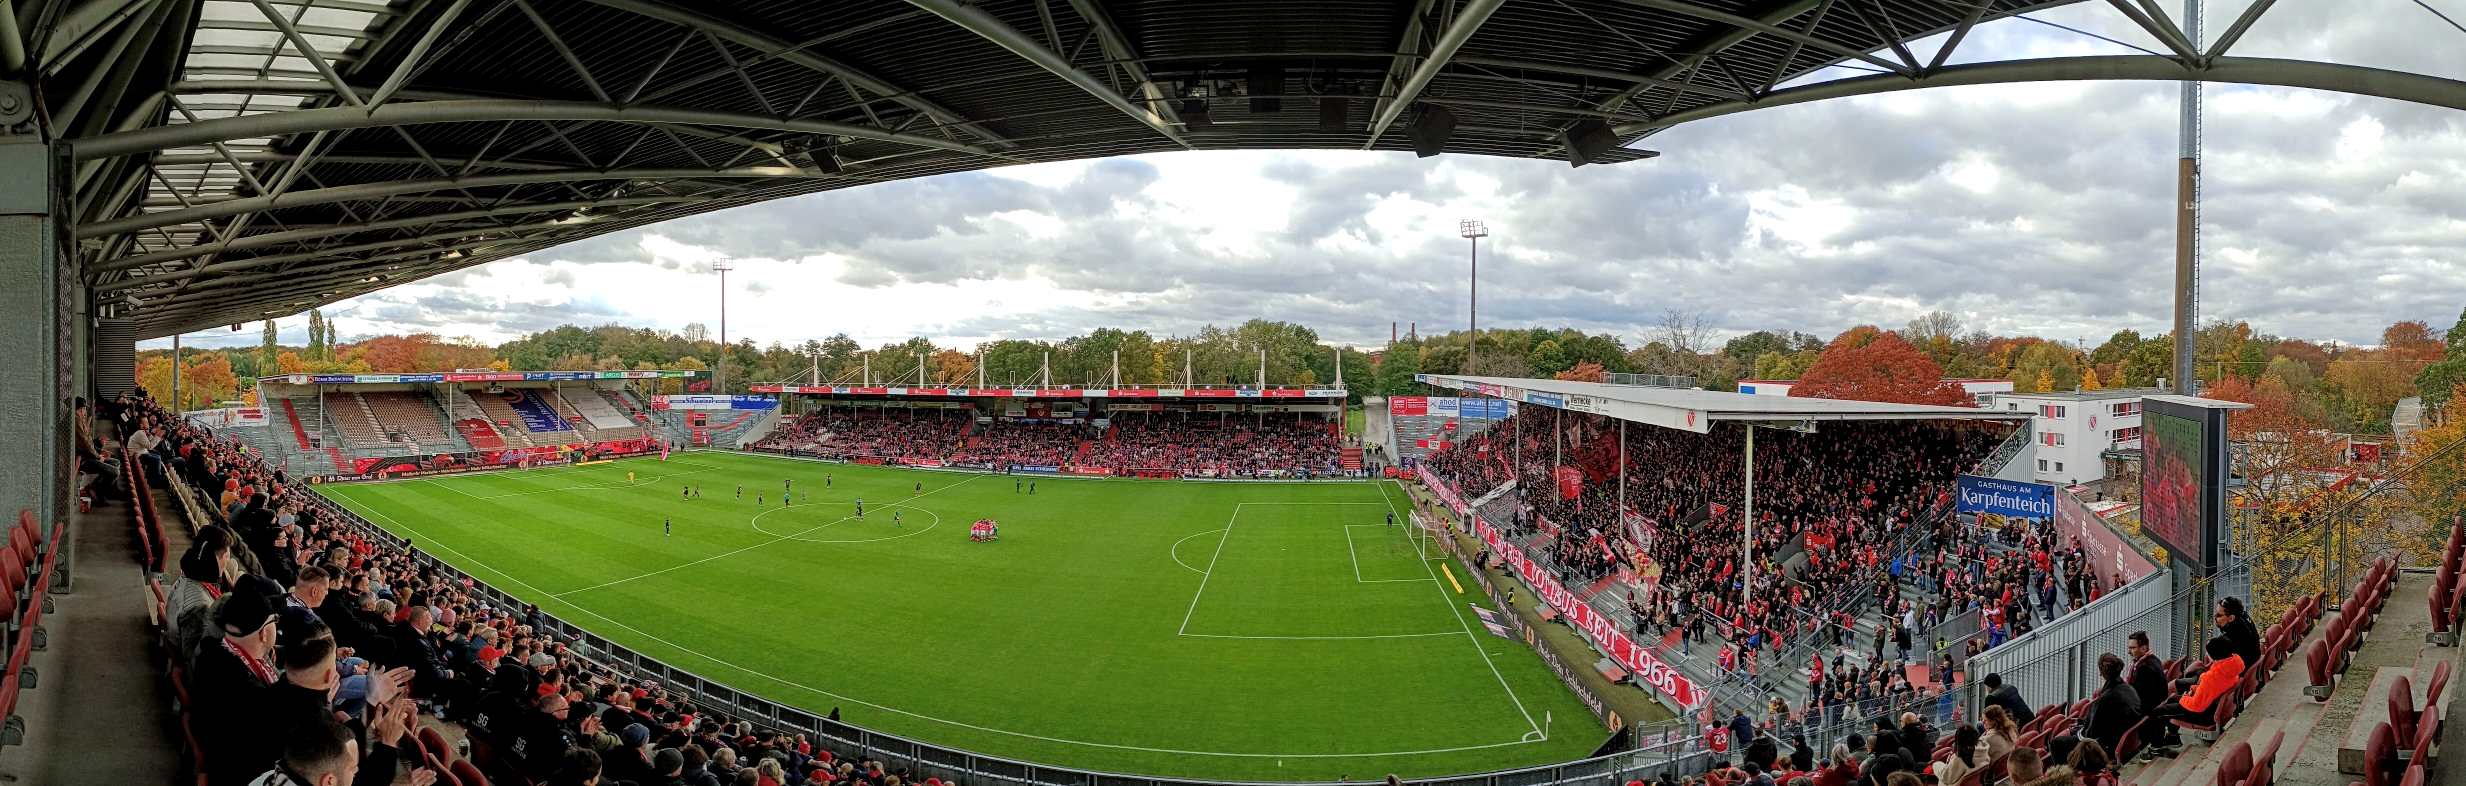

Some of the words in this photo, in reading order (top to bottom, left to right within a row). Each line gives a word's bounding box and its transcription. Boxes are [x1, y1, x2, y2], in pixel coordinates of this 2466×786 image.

[1977, 480, 2017, 492] GASTHAUS
[2019, 486, 2032, 494] AM
[1961, 486, 2051, 515] Karpfenteich
[1585, 608, 1620, 653] SEIT
[1627, 642, 1677, 697] 1966
[477, 712, 489, 727] SG
[515, 736, 527, 751] SG
[1713, 732, 1727, 745] 23
